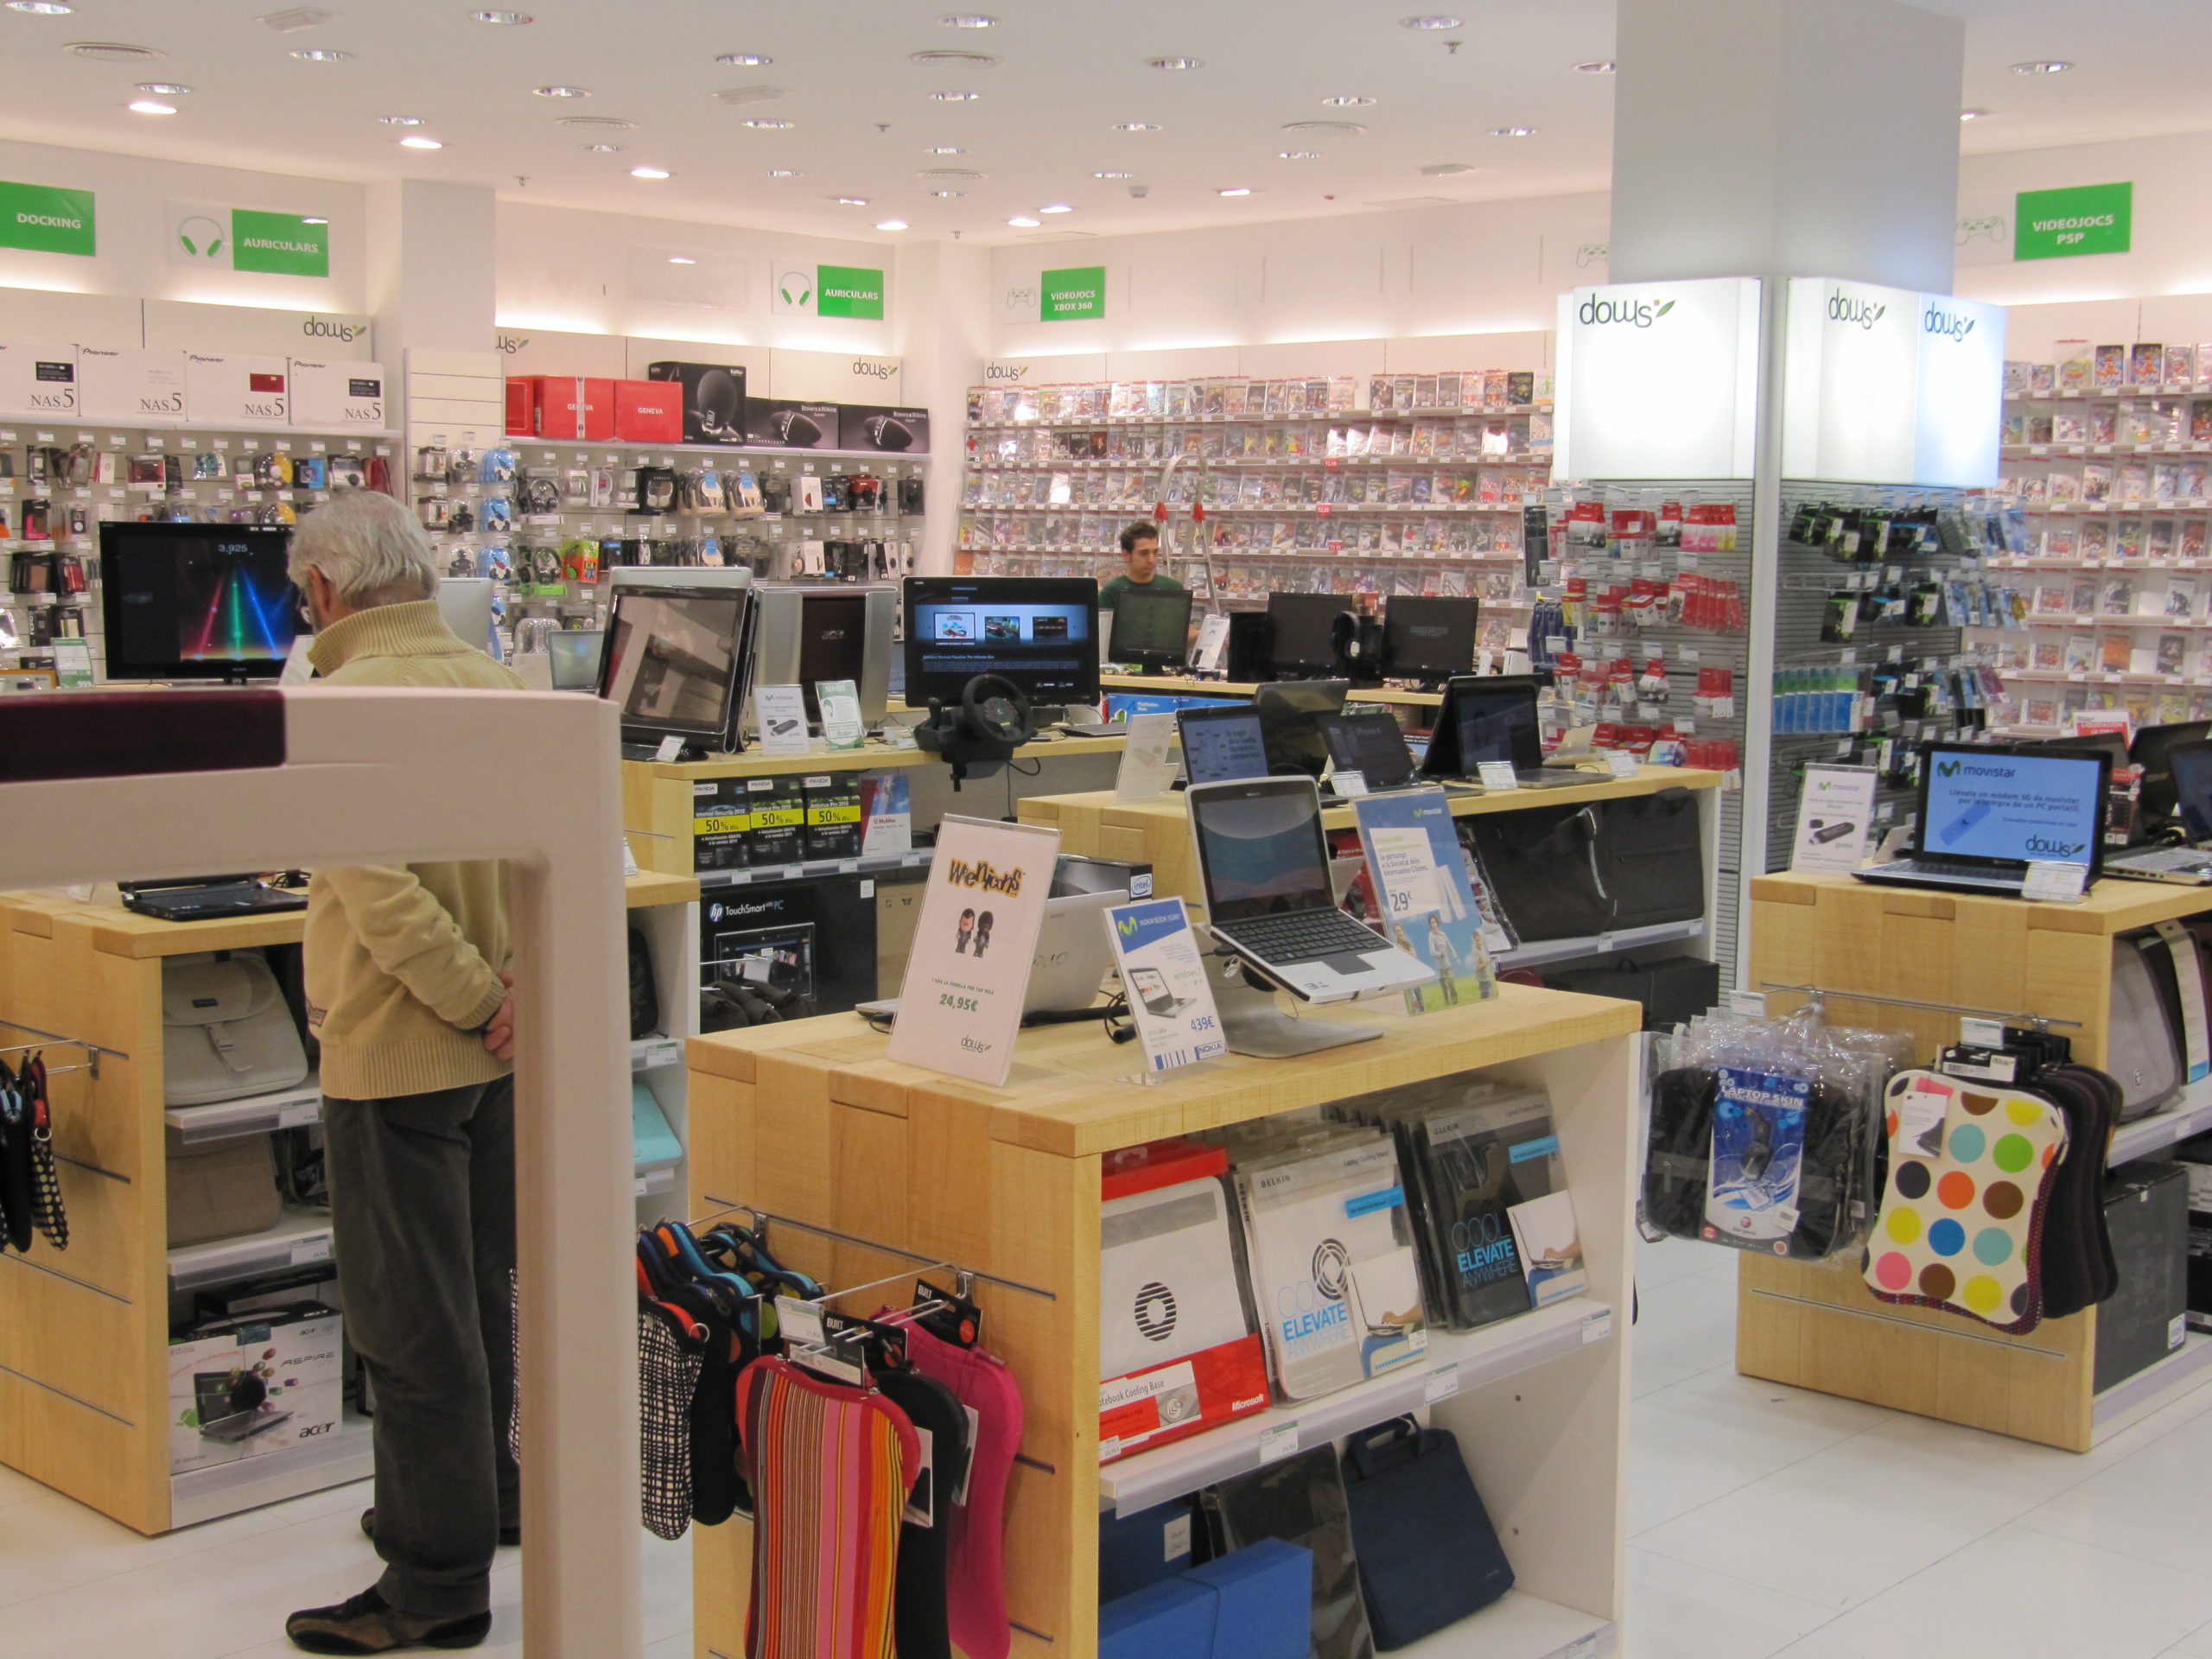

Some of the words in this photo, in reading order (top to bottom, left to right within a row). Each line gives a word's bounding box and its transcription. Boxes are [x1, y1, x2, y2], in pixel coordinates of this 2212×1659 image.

[16, 213, 82, 229] DOCKING
[2032, 214, 2113, 232] VIDEOJOCS
[244, 238, 319, 253] AURICULARS
[2056, 232, 2085, 245] PSP
[825, 288, 879, 301] AURICULARS
[1051, 290, 1096, 301] VIDEOJOCS
[1053, 302, 1077, 311] XBOX
[1077, 302, 1093, 311] 360
[1580, 293, 1653, 328] dows
[1828, 288, 1872, 329] dows
[304, 316, 353, 342] dows
[1924, 302, 1964, 342] dows
[189, 354, 225, 363] Pioneer
[294, 360, 326, 369] Pioneer
[853, 358, 888, 379] dows
[987, 362, 1019, 381] dows
[1963, 766, 2017, 778] movistar
[2025, 835, 2071, 857] dows
[1134, 880, 1149, 890] intel
[710, 905, 723, 922] hp
[726, 903, 766, 916] TouchSmart
[773, 900, 784, 910] PC
[939, 993, 979, 1012] 24,95€
[1191, 1015, 1215, 1031] 439€
[1198, 1042, 1222, 1053] NOKIA
[1720, 1085, 1771, 1102] LAPTOP
[1772, 1093, 1803, 1107] SKIN
[1261, 1174, 1291, 1188] BELKIN
[1238, 1182, 1250, 1222] BELKIN
[1457, 1238, 1514, 1272] ELEVATE
[1463, 1257, 1518, 1287] ANYWHERE
[918, 1284, 932, 1299] BUILT
[826, 1317, 844, 1331] BUILT
[1282, 1301, 1348, 1341] ELEVATE
[280, 1351, 335, 1367] ASPIRE
[1098, 1391, 1124, 1408] otebook
[1124, 1384, 1149, 1399] Cooling
[1149, 1379, 1165, 1390] Base
[1231, 1393, 1265, 1412] Microsoft
[299, 1421, 336, 1439] acer
